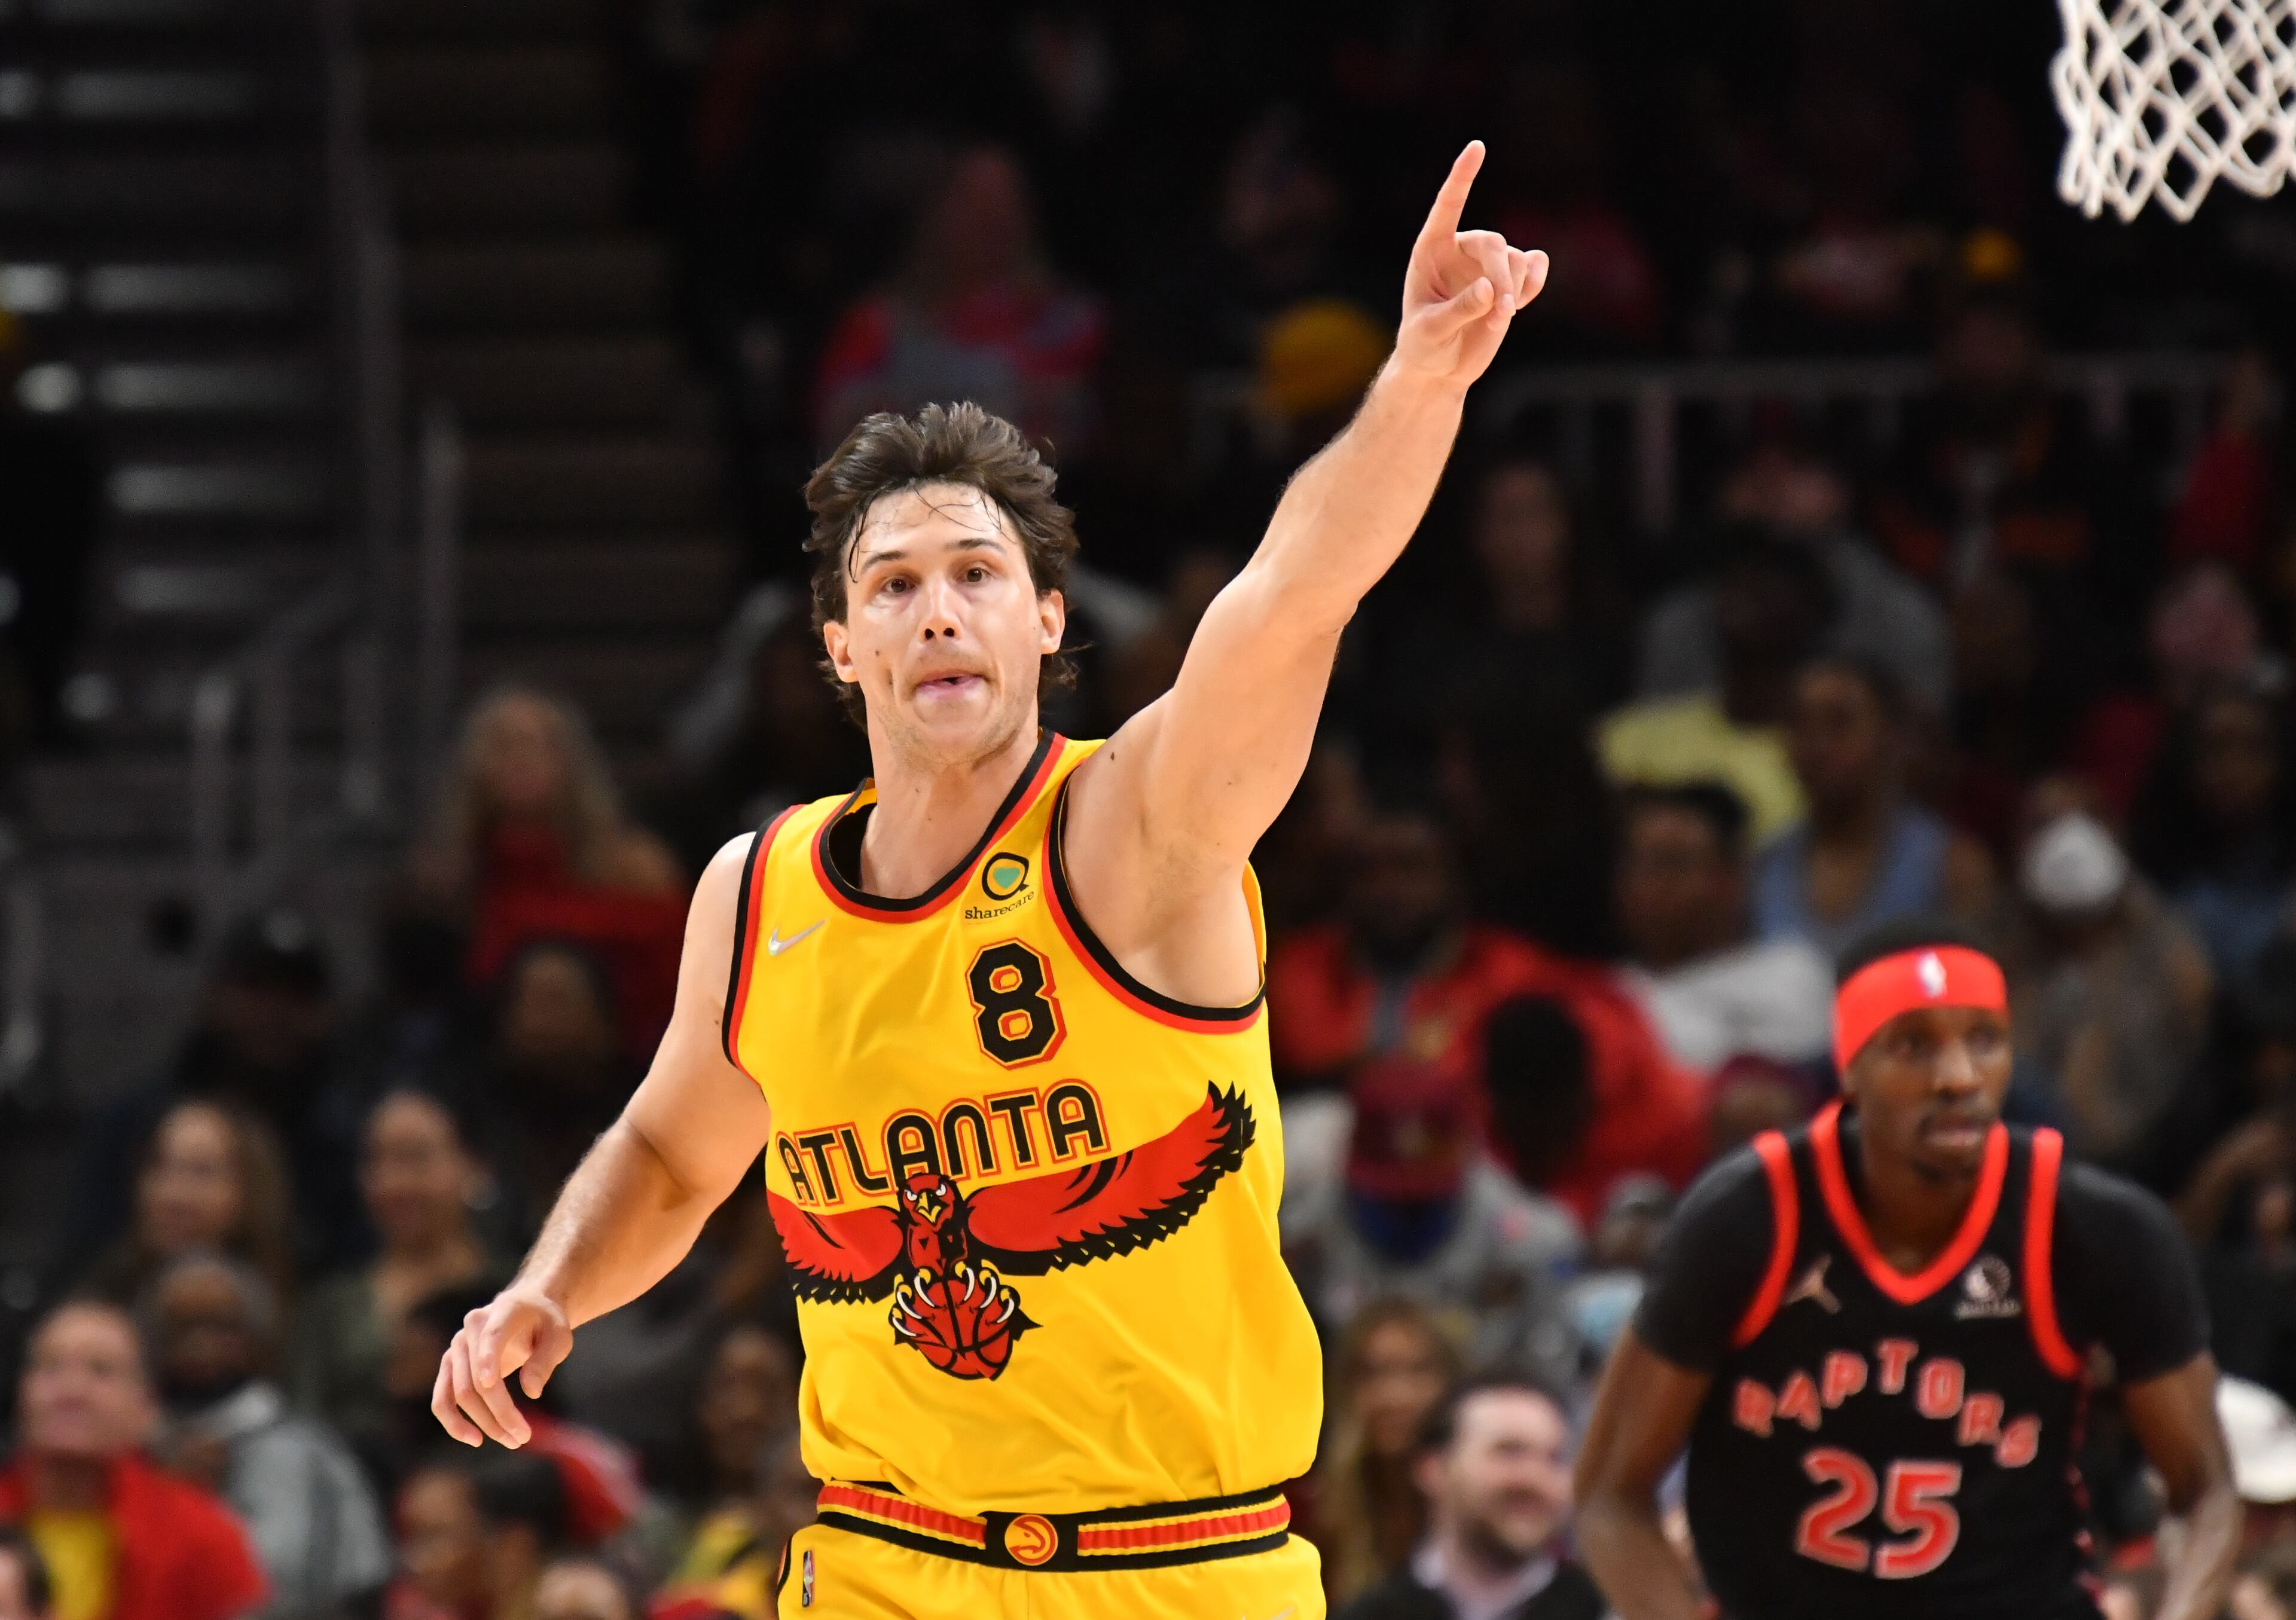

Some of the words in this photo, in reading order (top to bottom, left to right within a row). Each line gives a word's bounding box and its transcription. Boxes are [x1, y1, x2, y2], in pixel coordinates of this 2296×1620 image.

[964, 891, 1034, 919] sharecare
[965, 937, 1067, 1070] 8
[776, 1078, 1111, 1206] ATLANTA
[1734, 1337, 2041, 1468] RAPTORS
[1797, 1446, 1963, 1579] 25
